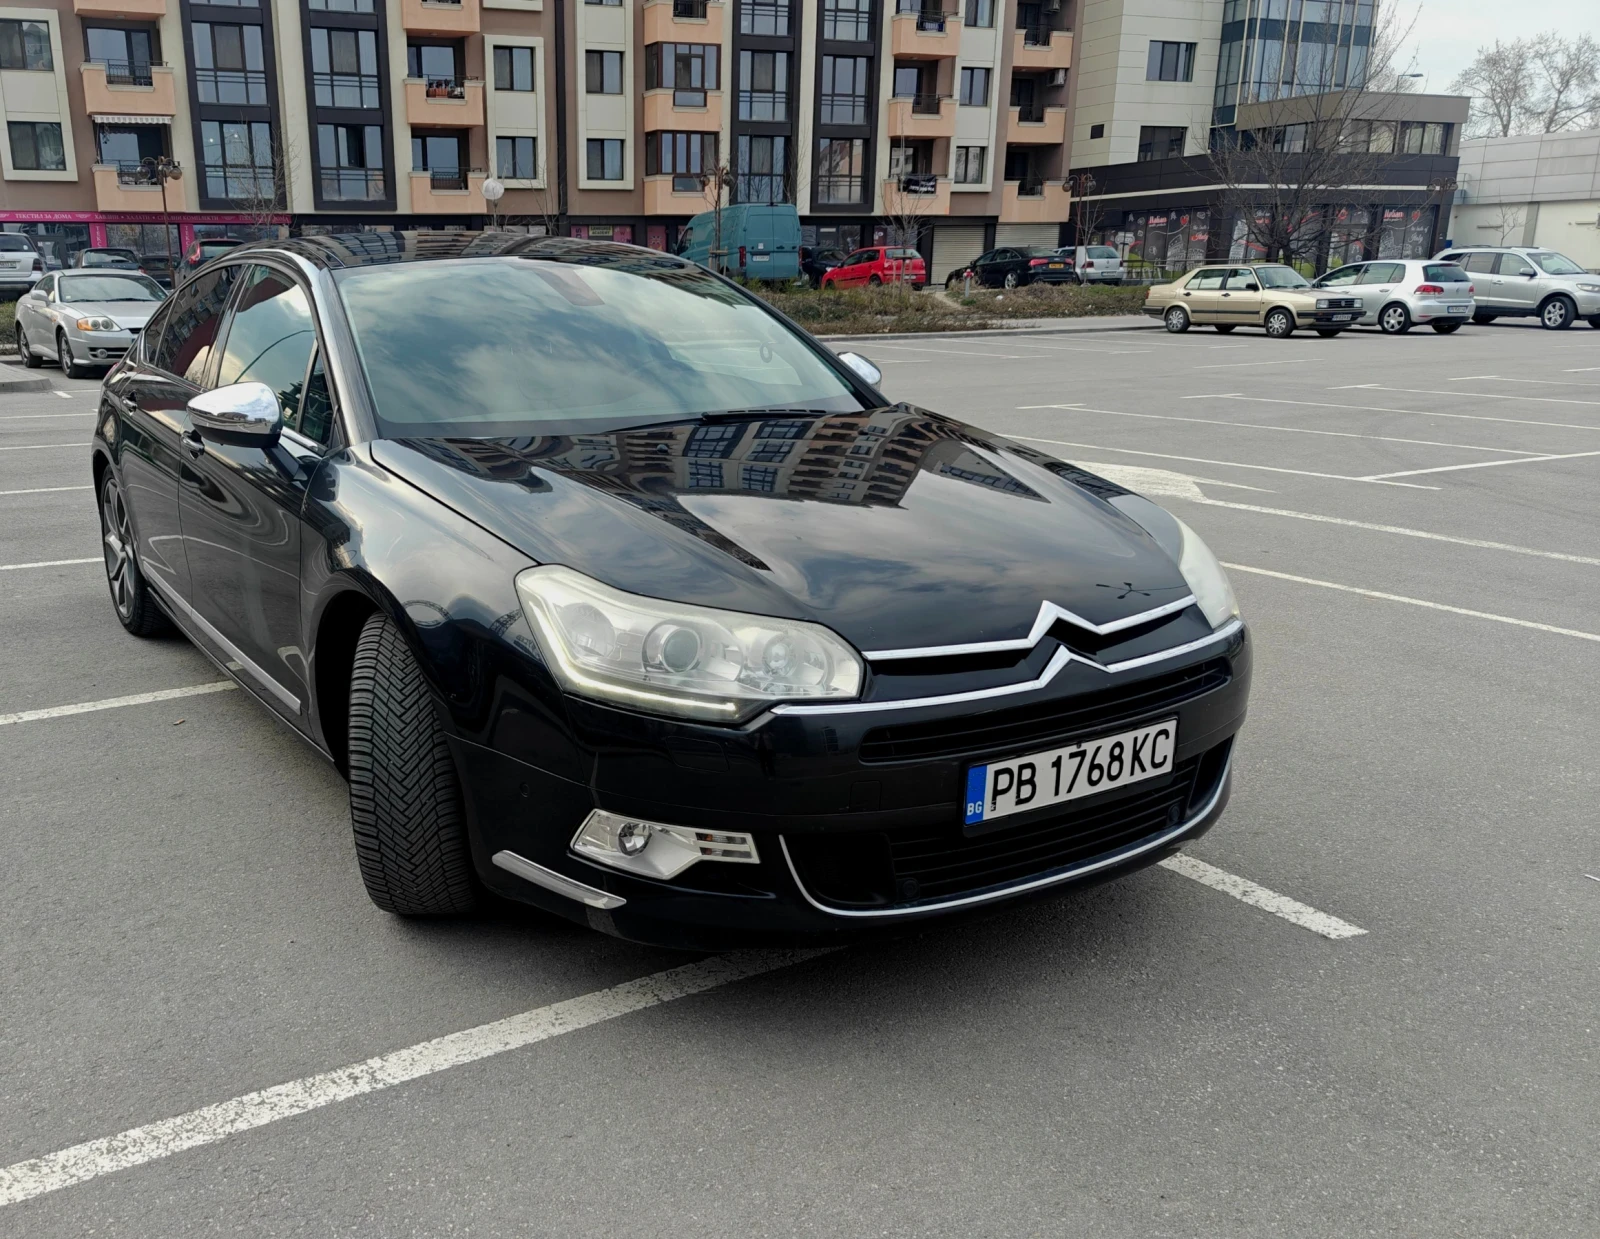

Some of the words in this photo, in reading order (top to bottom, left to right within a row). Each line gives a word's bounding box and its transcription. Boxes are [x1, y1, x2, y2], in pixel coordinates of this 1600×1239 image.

[990, 762, 1037, 811] PB
[1051, 740, 1125, 797] 1768
[1129, 728, 1170, 777] KC
[966, 801, 983, 816] BG
